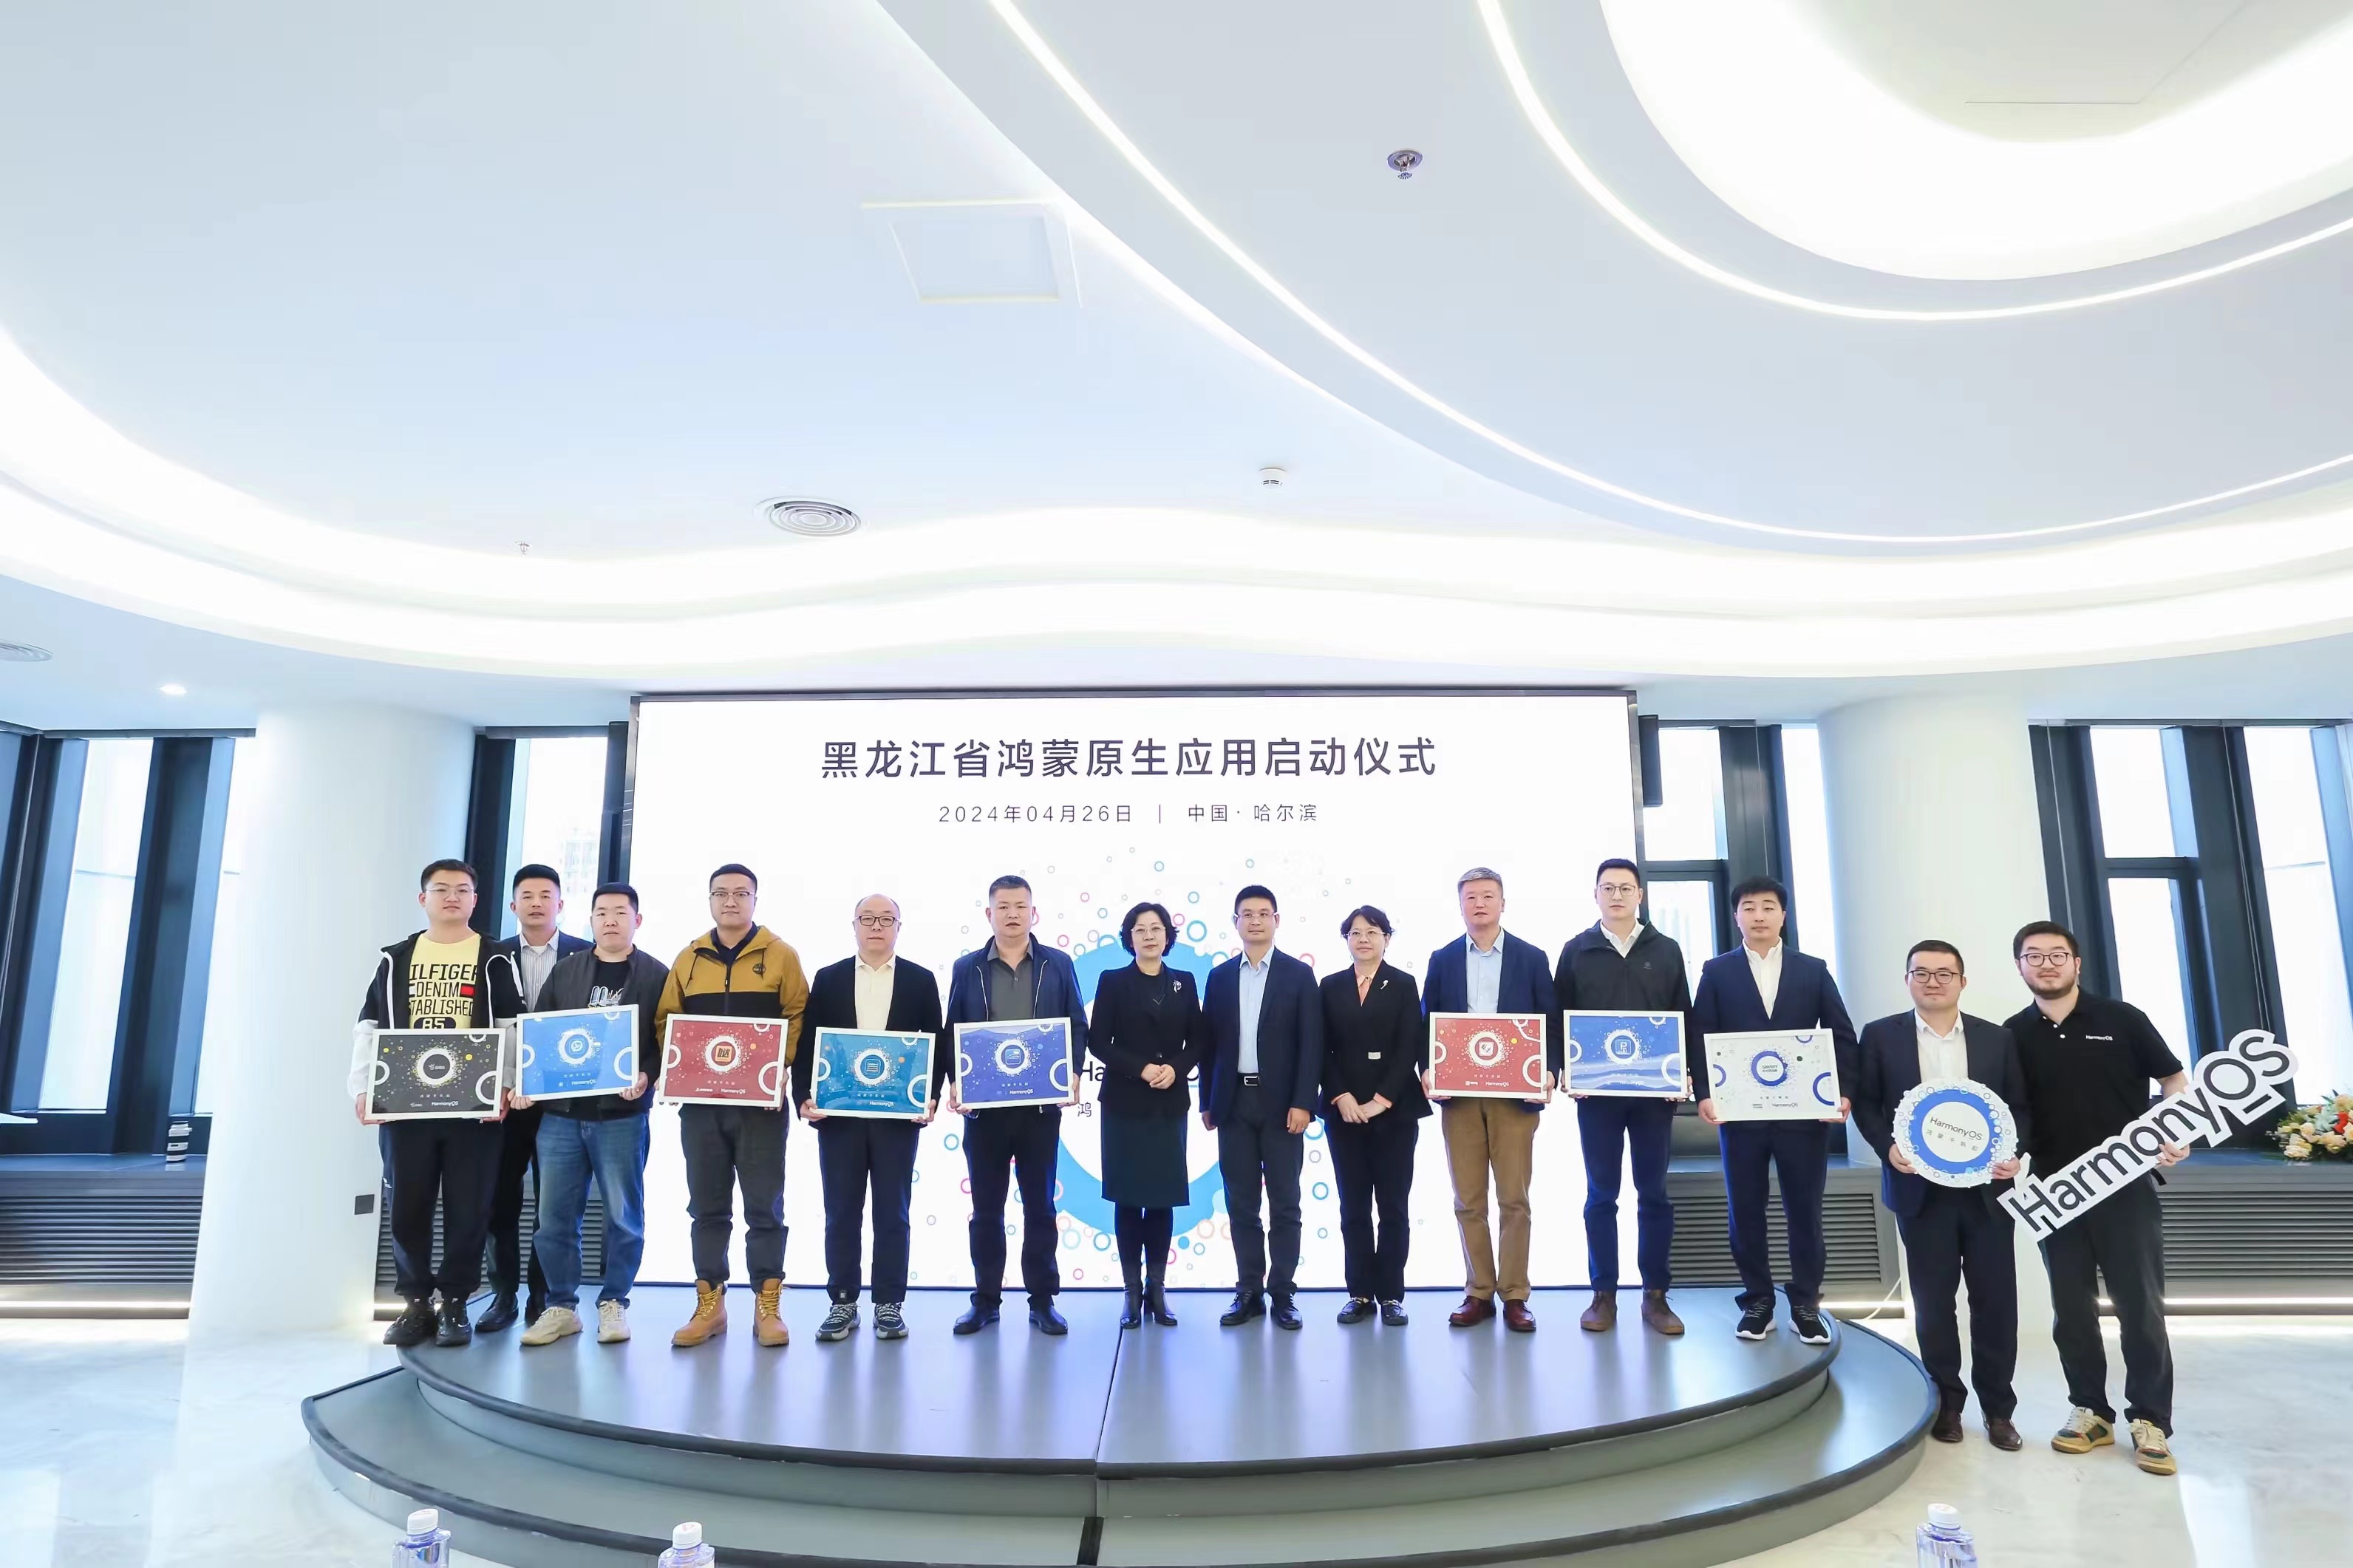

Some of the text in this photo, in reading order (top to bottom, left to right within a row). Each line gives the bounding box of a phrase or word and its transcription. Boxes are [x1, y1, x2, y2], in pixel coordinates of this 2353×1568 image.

[821, 737, 1436, 779] 黑龙江省鸿蒙原生应用启动仪式
[939, 805, 1133, 823] 2024年04月26日
[416, 981, 460, 998] DENIM
[1930, 1117, 1983, 1141] HarmonyOS
[2007, 1036, 2290, 1233] HarmonyOS
